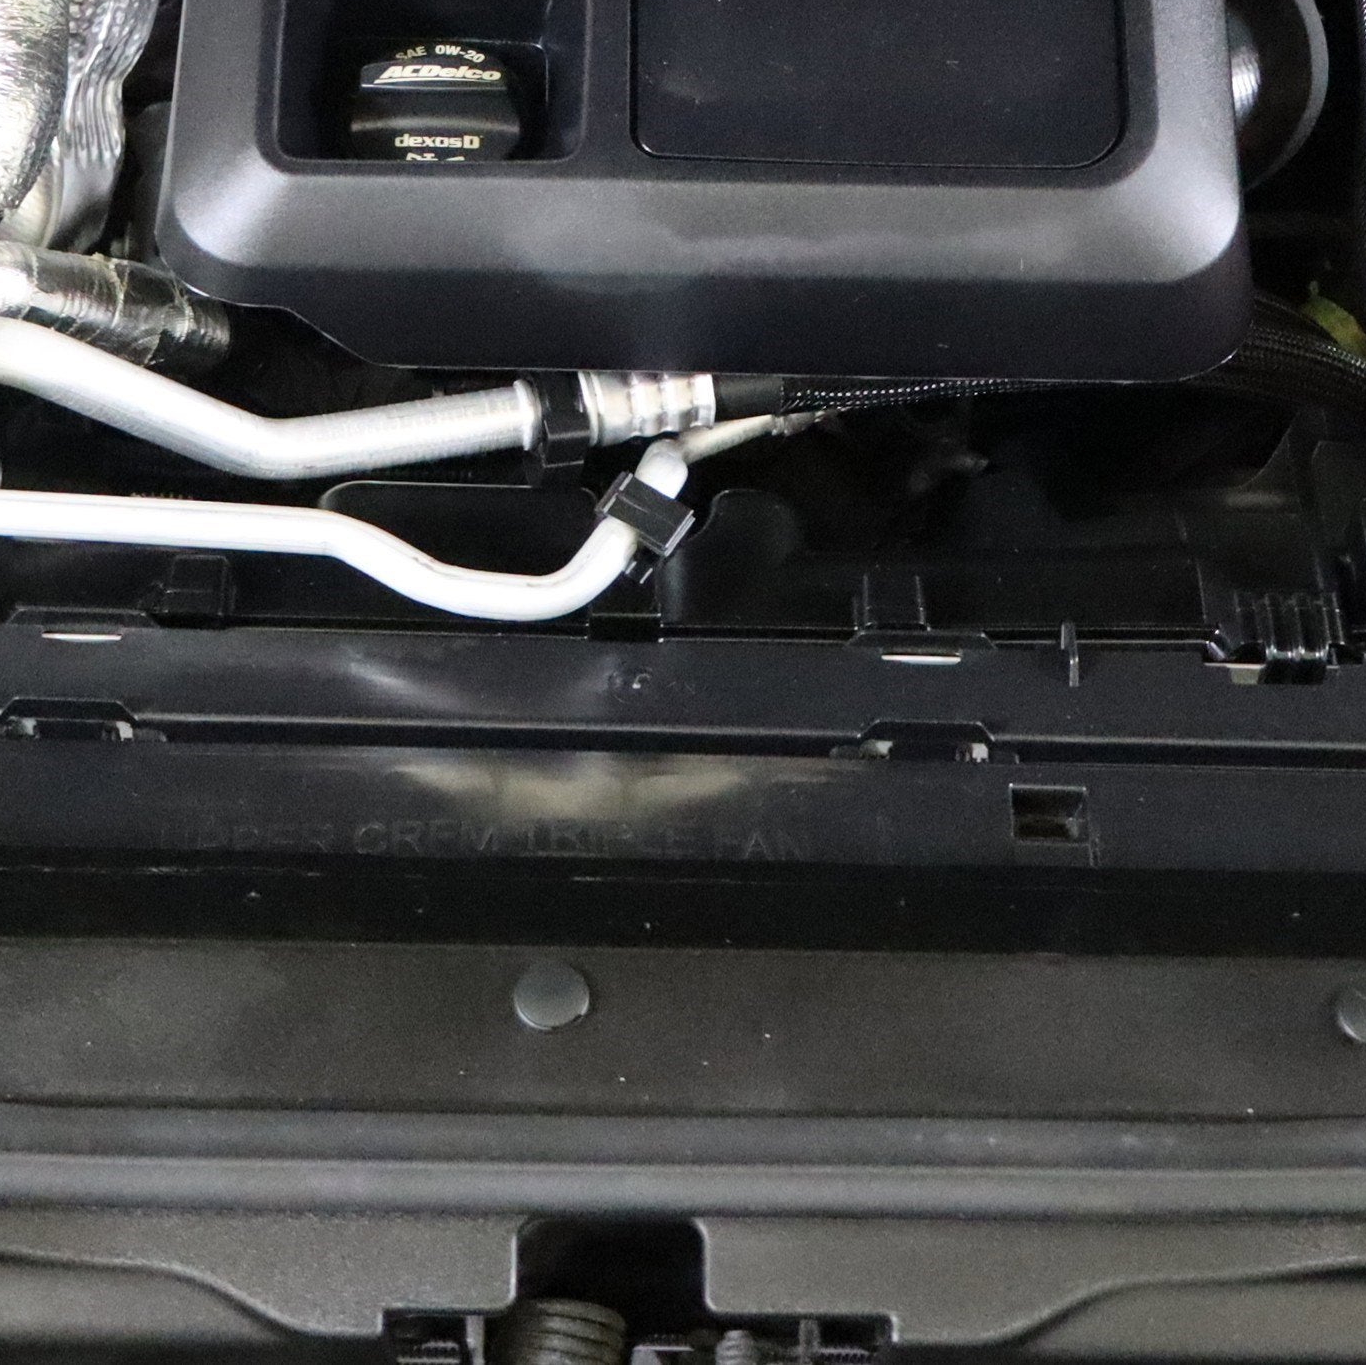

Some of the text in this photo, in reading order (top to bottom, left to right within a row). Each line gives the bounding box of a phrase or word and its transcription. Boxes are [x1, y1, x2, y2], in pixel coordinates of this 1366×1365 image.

[395, 44, 487, 64] SAE 0W-20
[375, 64, 502, 83] ACDelco
[394, 133, 481, 150] dexosD
